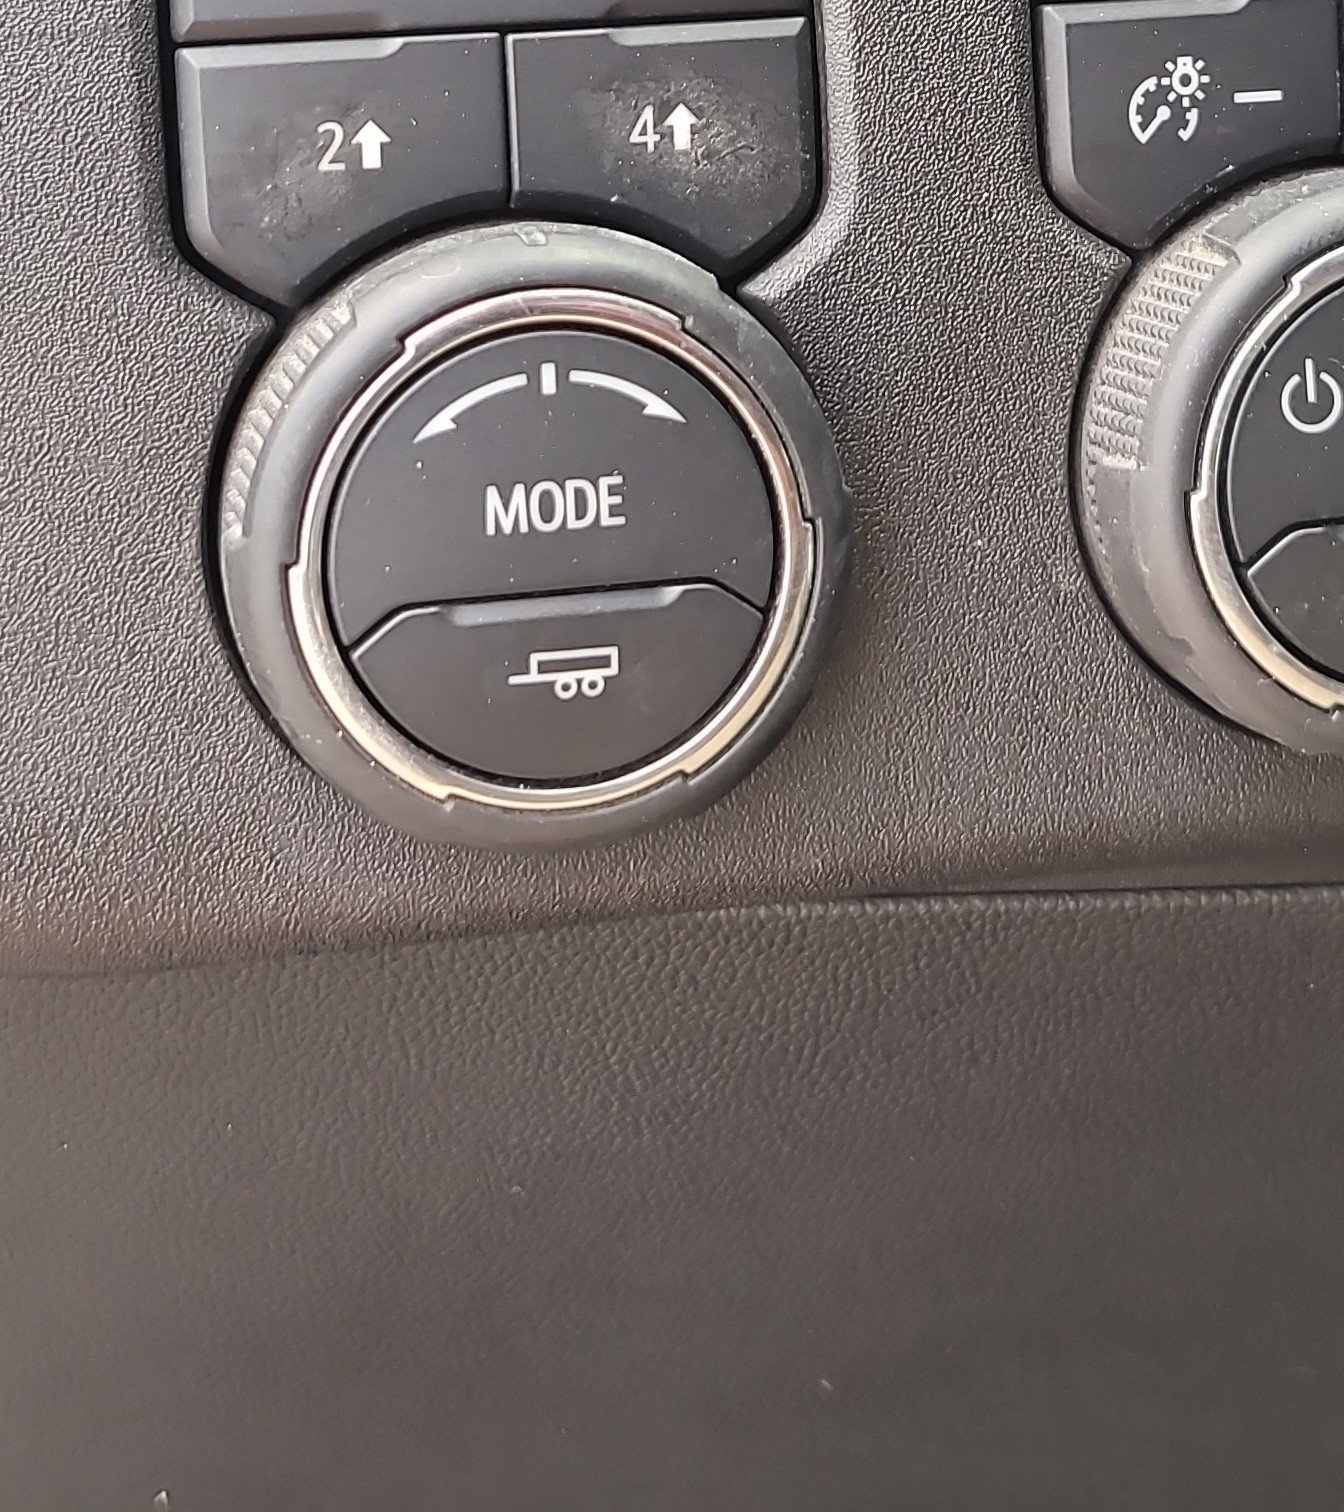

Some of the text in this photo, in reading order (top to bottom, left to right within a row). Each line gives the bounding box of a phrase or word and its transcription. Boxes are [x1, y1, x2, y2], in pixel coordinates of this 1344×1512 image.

[316, 120, 347, 172] 2
[628, 103, 662, 155] 4
[483, 473, 626, 537] MODE
